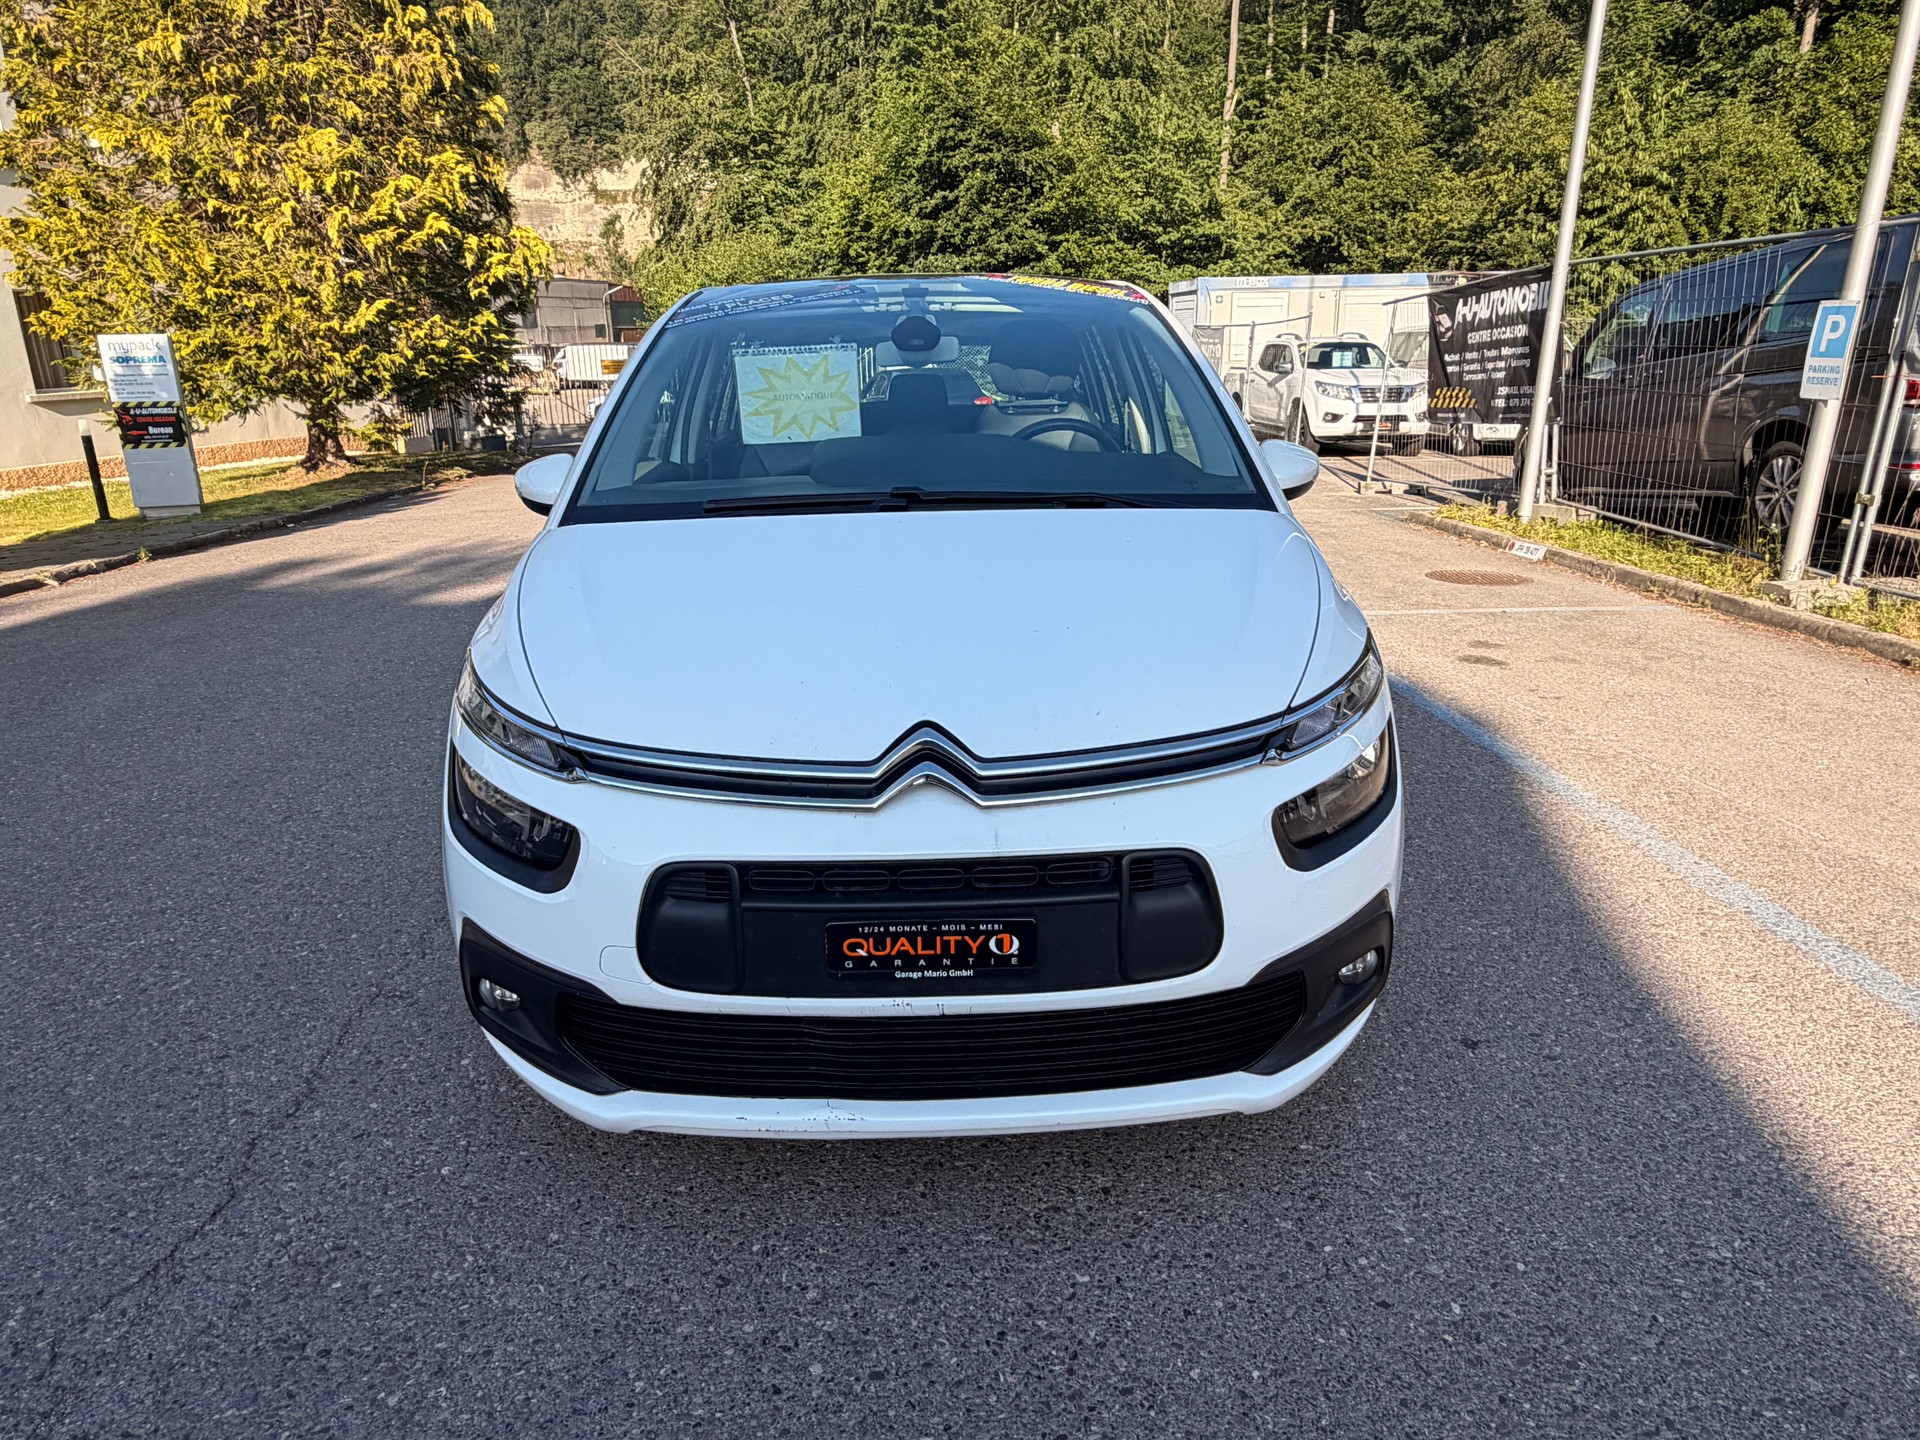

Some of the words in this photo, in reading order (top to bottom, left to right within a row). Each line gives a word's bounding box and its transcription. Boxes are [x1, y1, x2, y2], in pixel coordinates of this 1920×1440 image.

[725, 294, 794, 309] PLACES
[1468, 329, 1491, 344] CENTRE
[1492, 324, 1529, 340] OCCASION
[1819, 314, 1847, 352] P
[108, 339, 162, 353] mypack
[109, 355, 167, 364] SOPREMA
[1808, 365, 1840, 374] PARKING
[773, 391, 834, 401] AUTOMATIQUE
[842, 935, 986, 957] QUALITY
[845, 957, 1018, 968] GARANTIE
[895, 970, 923, 979] Garage
[924, 969, 947, 977] Mario
[949, 969, 973, 977] GmbH
